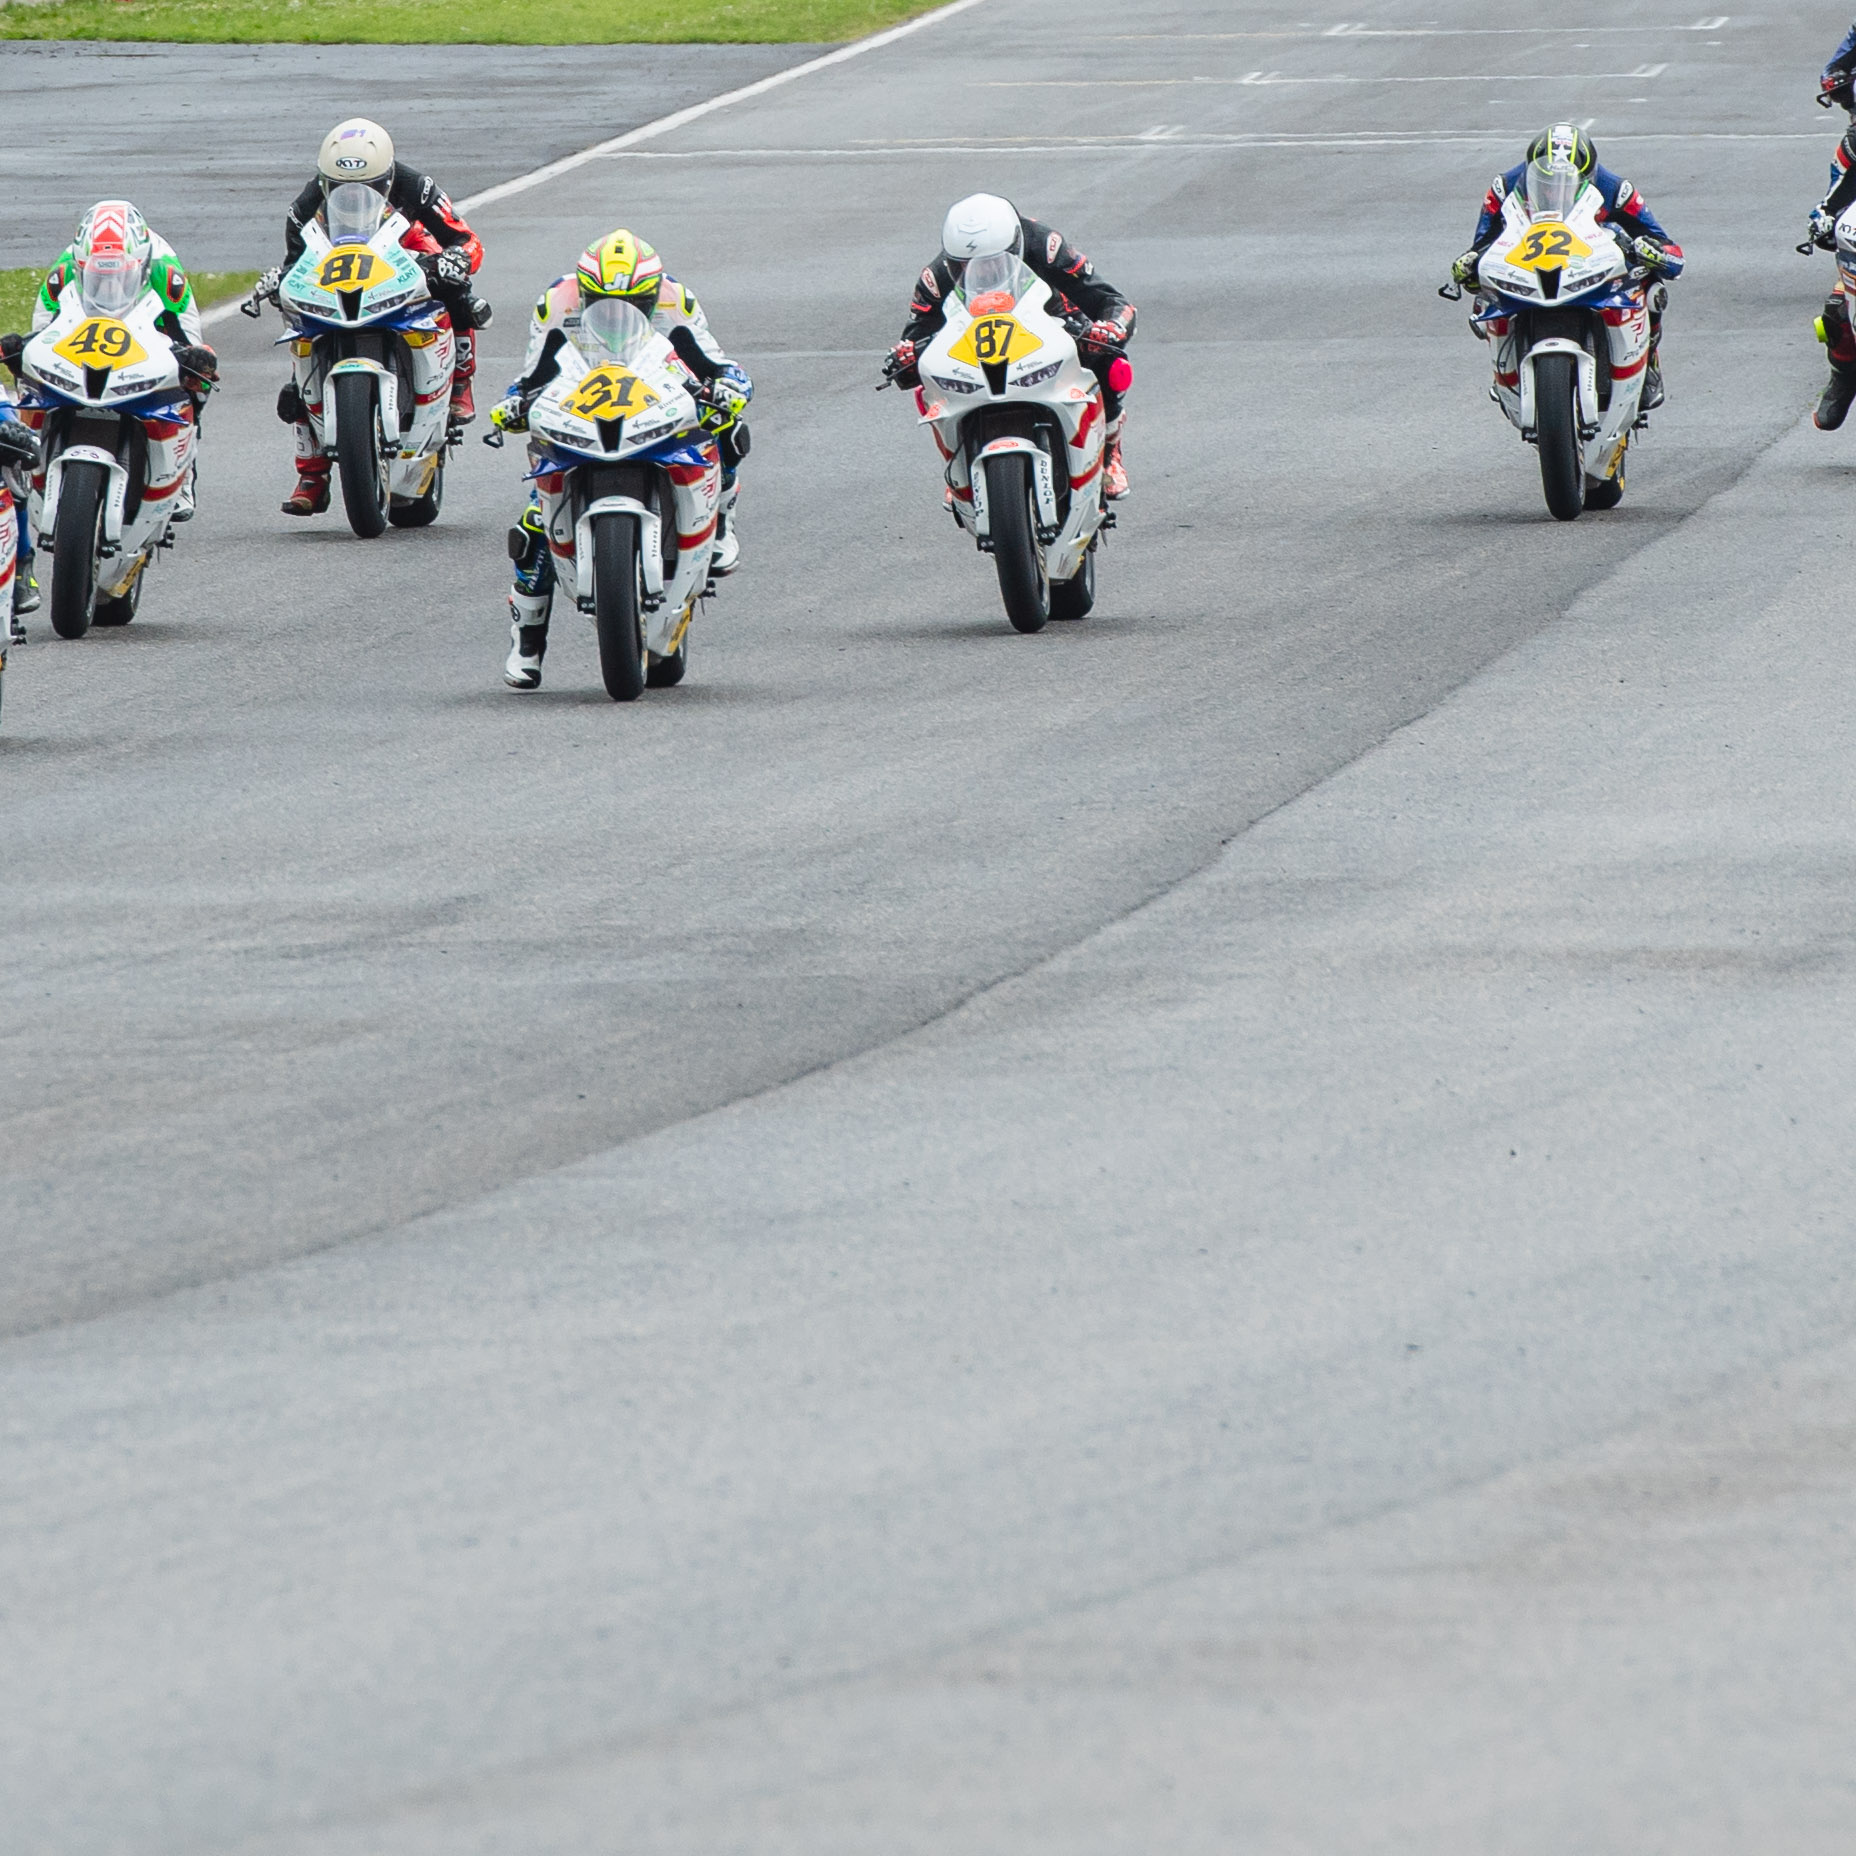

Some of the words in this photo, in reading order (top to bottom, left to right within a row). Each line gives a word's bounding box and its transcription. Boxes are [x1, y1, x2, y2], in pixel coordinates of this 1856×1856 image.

[1521, 229, 1573, 262] 32
[319, 253, 375, 286] 81
[67, 322, 132, 357] 49
[974, 319, 1015, 358] 87
[576, 373, 639, 415] 31
